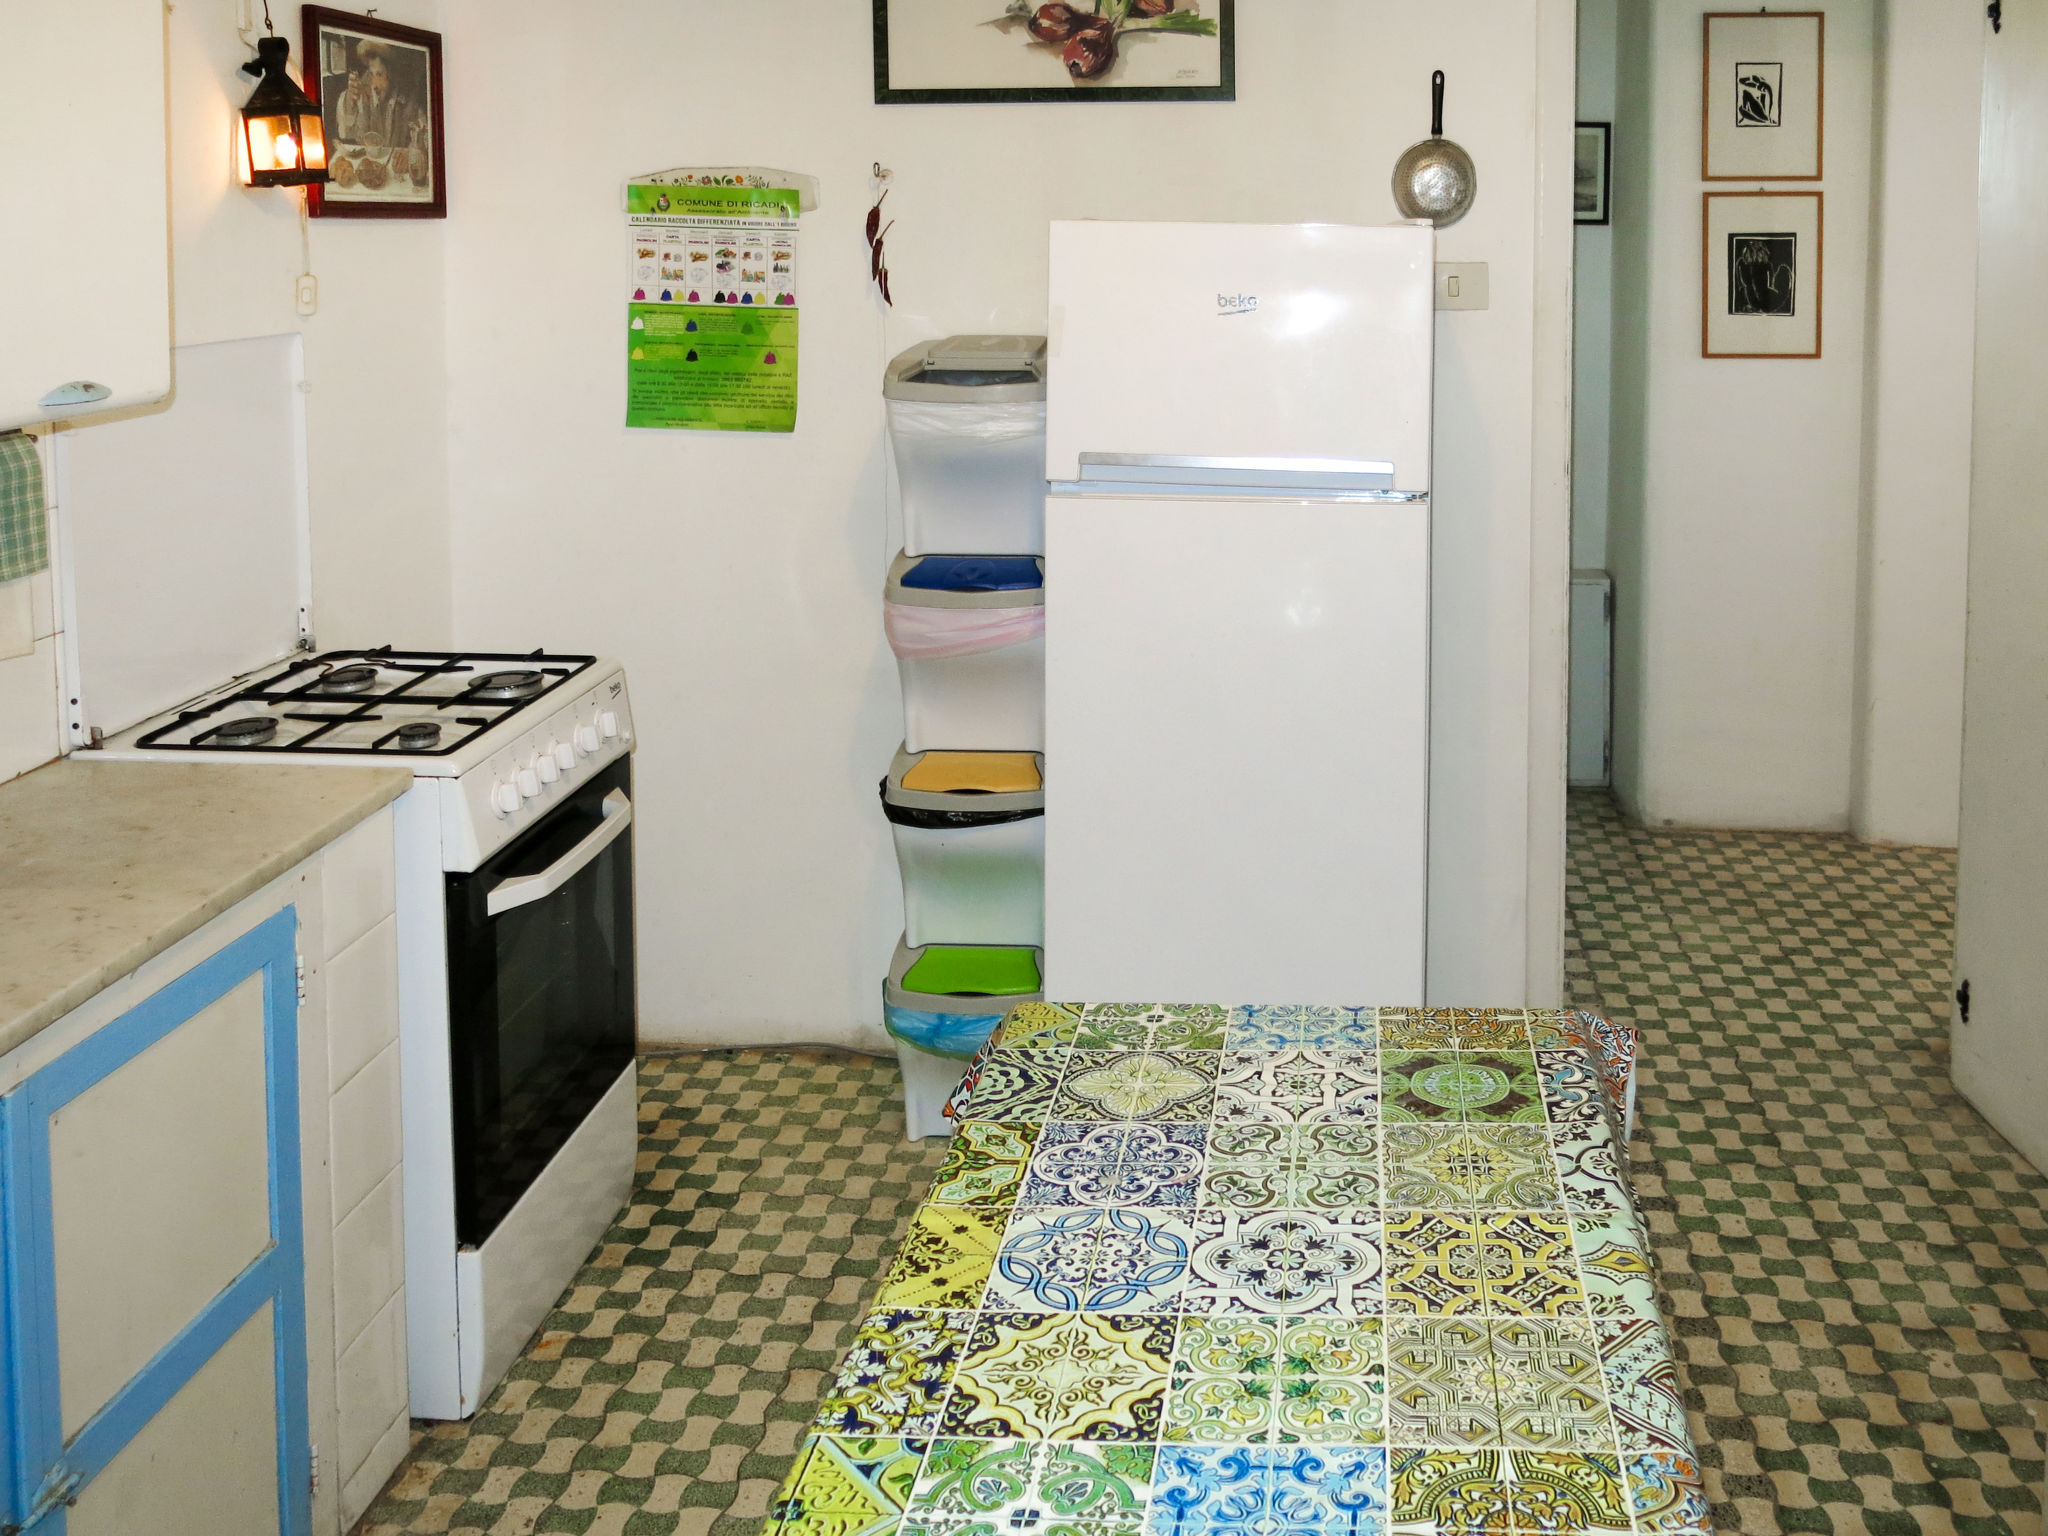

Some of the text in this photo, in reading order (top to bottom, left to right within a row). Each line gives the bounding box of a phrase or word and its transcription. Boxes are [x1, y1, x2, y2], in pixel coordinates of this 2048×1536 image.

[677, 198, 780, 209] COMUNE DI RICADI
[697, 218, 741, 226] DIFFERENZIATA
[1217, 293, 1258, 308] beko
